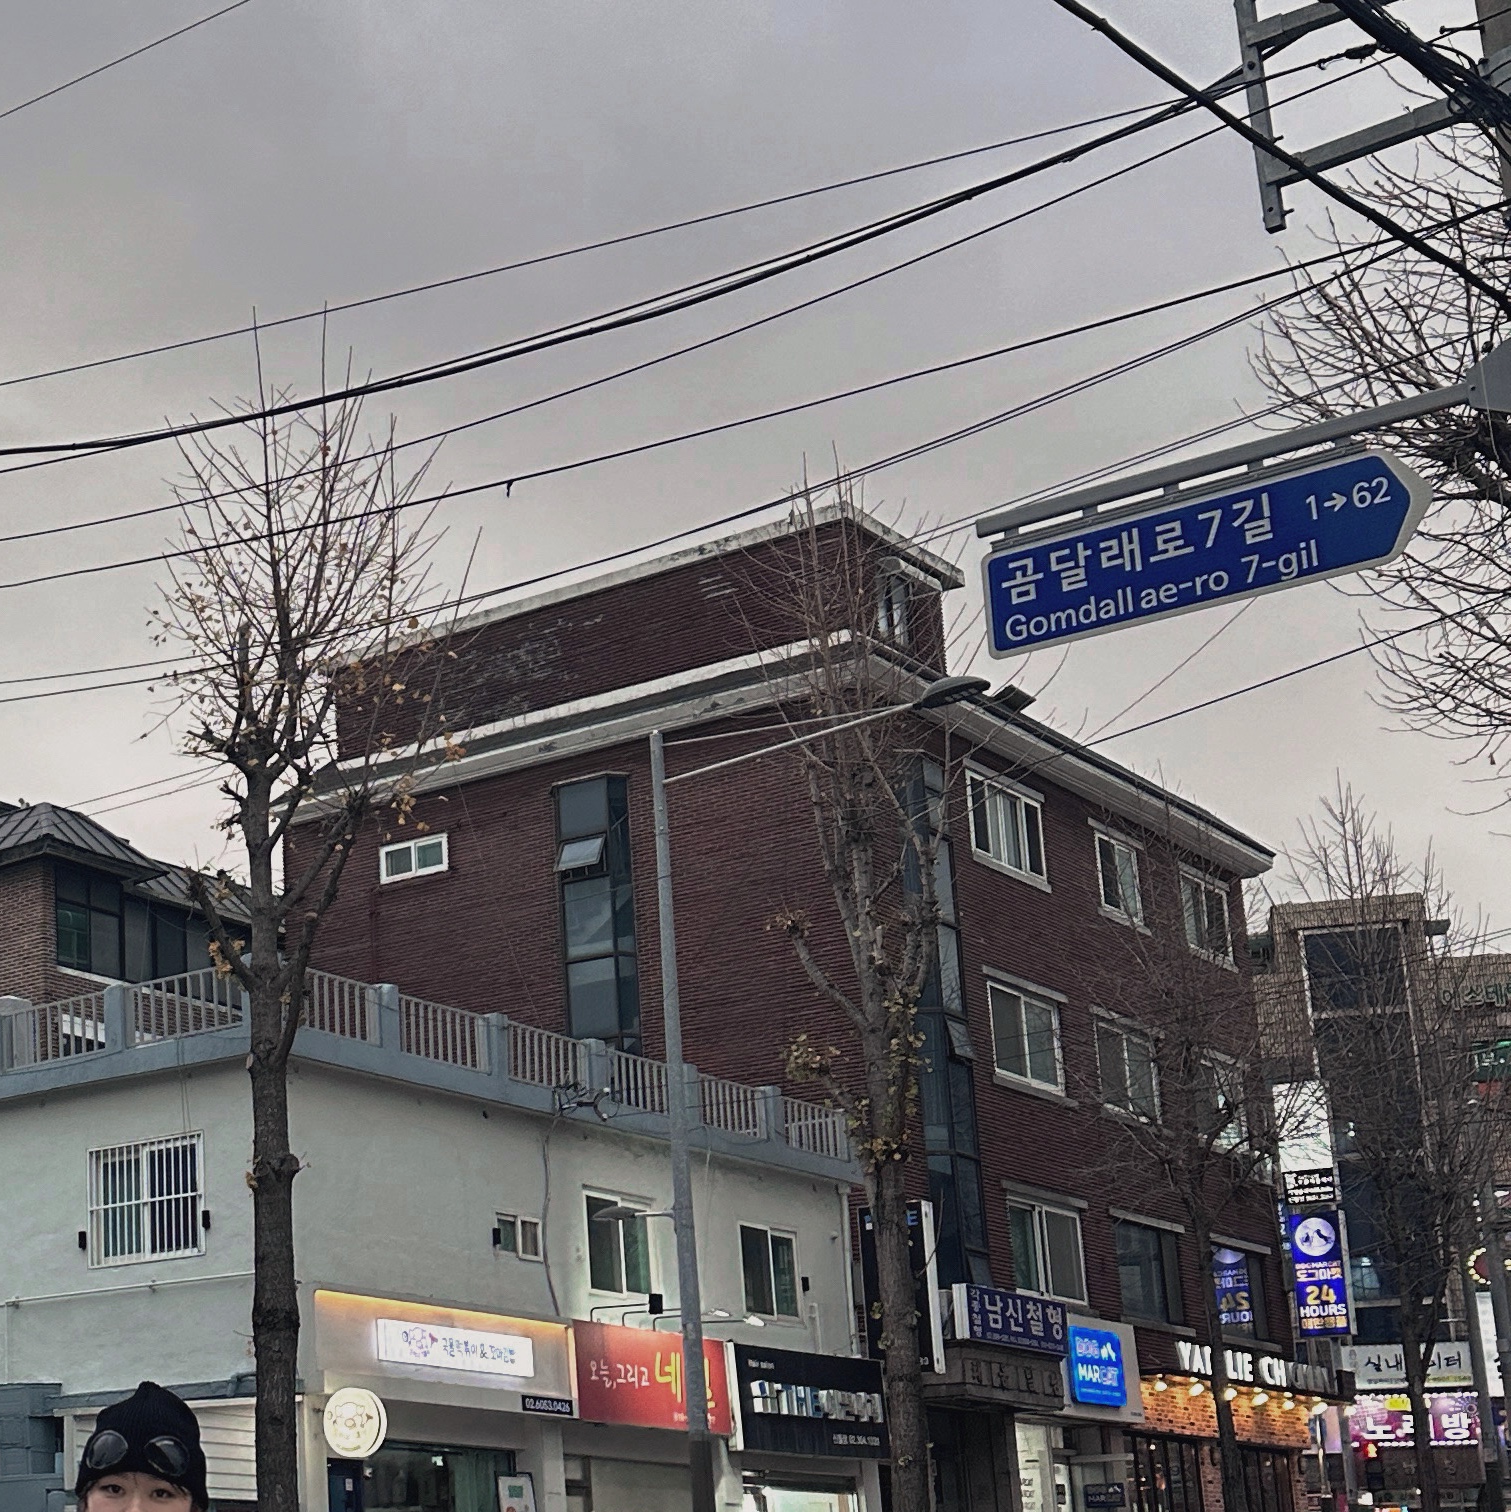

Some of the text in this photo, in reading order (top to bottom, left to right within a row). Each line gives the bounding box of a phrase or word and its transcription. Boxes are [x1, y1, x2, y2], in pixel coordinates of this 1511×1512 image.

[1001, 492, 1274, 605] 곰달래로7길
[1241, 538, 1320, 585] 7-gil
[1299, 1303, 1347, 1318] HOURS
[1305, 1284, 1337, 1305] 24
